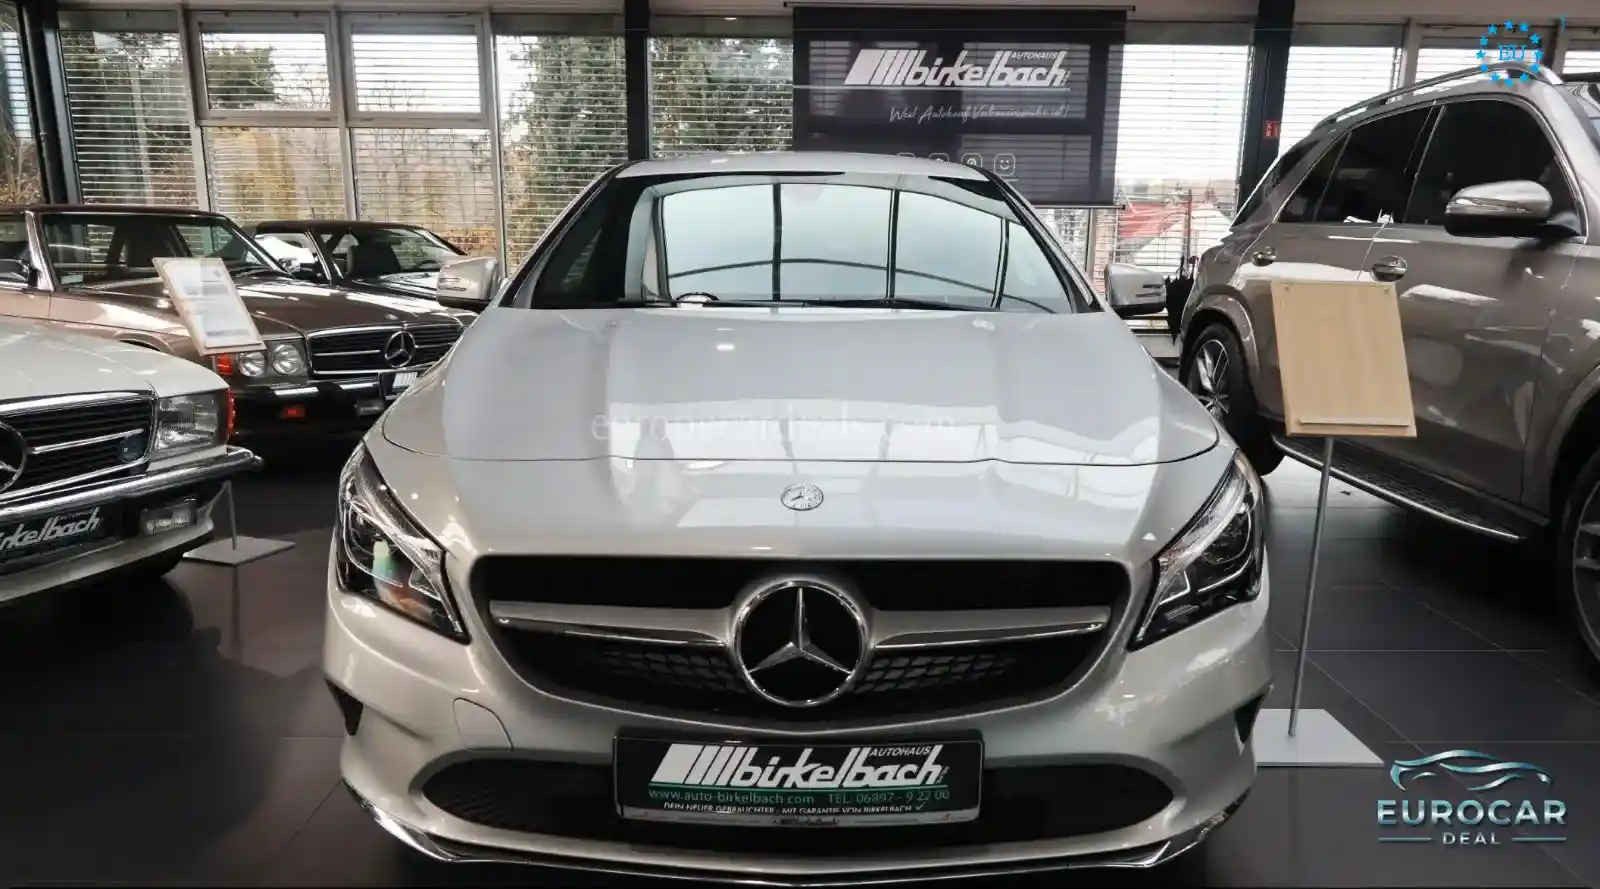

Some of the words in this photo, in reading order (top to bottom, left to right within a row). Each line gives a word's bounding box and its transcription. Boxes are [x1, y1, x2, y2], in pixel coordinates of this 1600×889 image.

[906, 48, 1068, 87] birkelbach
[1011, 51, 1057, 60] AUTOHAUS
[0, 507, 101, 551] rkelbach
[869, 745, 931, 757] AUTOHAUS
[730, 744, 945, 789] birkelbach
[648, 788, 815, 805] www.auto-birkelbach.com
[856, 792, 895, 804] 06897
[906, 792, 914, 803] 9
[934, 789, 950, 801] 00
